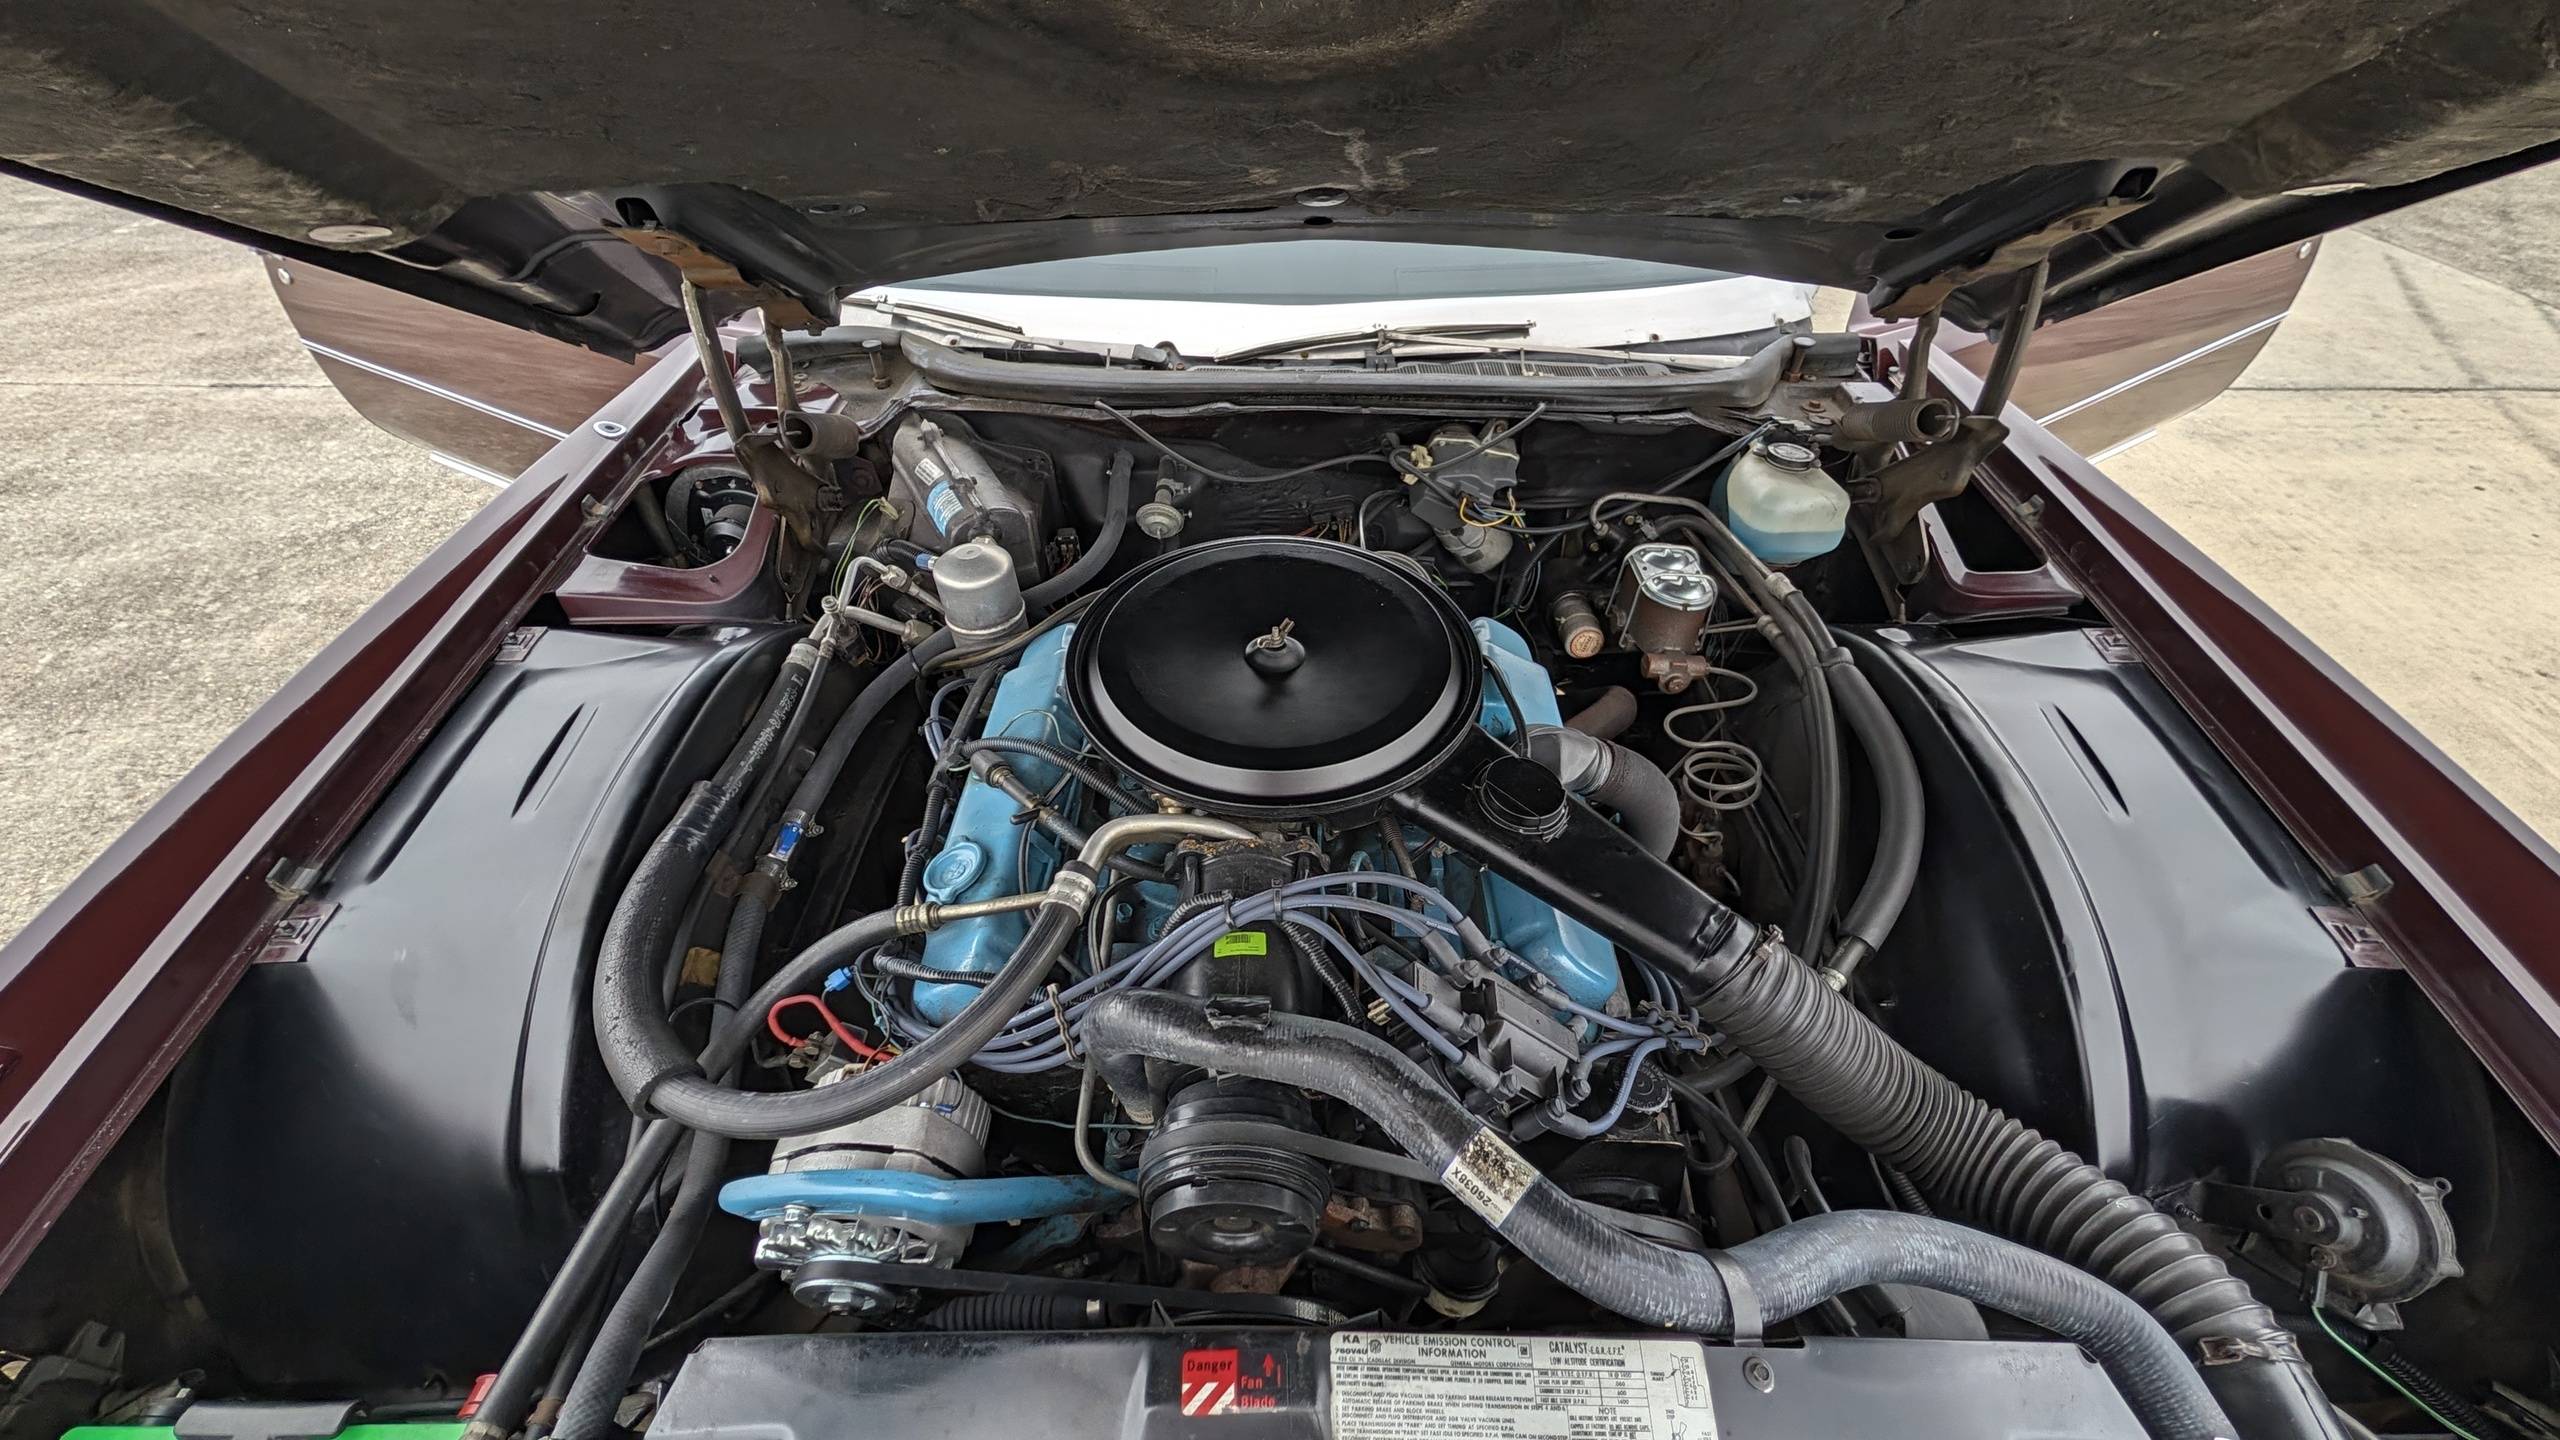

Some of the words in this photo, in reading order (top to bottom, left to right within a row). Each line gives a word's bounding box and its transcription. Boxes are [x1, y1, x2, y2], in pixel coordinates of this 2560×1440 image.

[1451, 1166, 1493, 1207] 26038X
[1342, 1334, 1361, 1344] KA
[1383, 1335, 1420, 1346] VEHICLE
[1423, 1336, 1467, 1348] EMISSION
[1470, 1338, 1516, 1348] CONTROL
[1418, 1347, 1487, 1359] INFORMATION
[1187, 1360, 1232, 1374] Danger
[1241, 1376, 1263, 1389] Fan
[1241, 1395, 1275, 1408] Blade
[1599, 1407, 1616, 1415] NOTE
